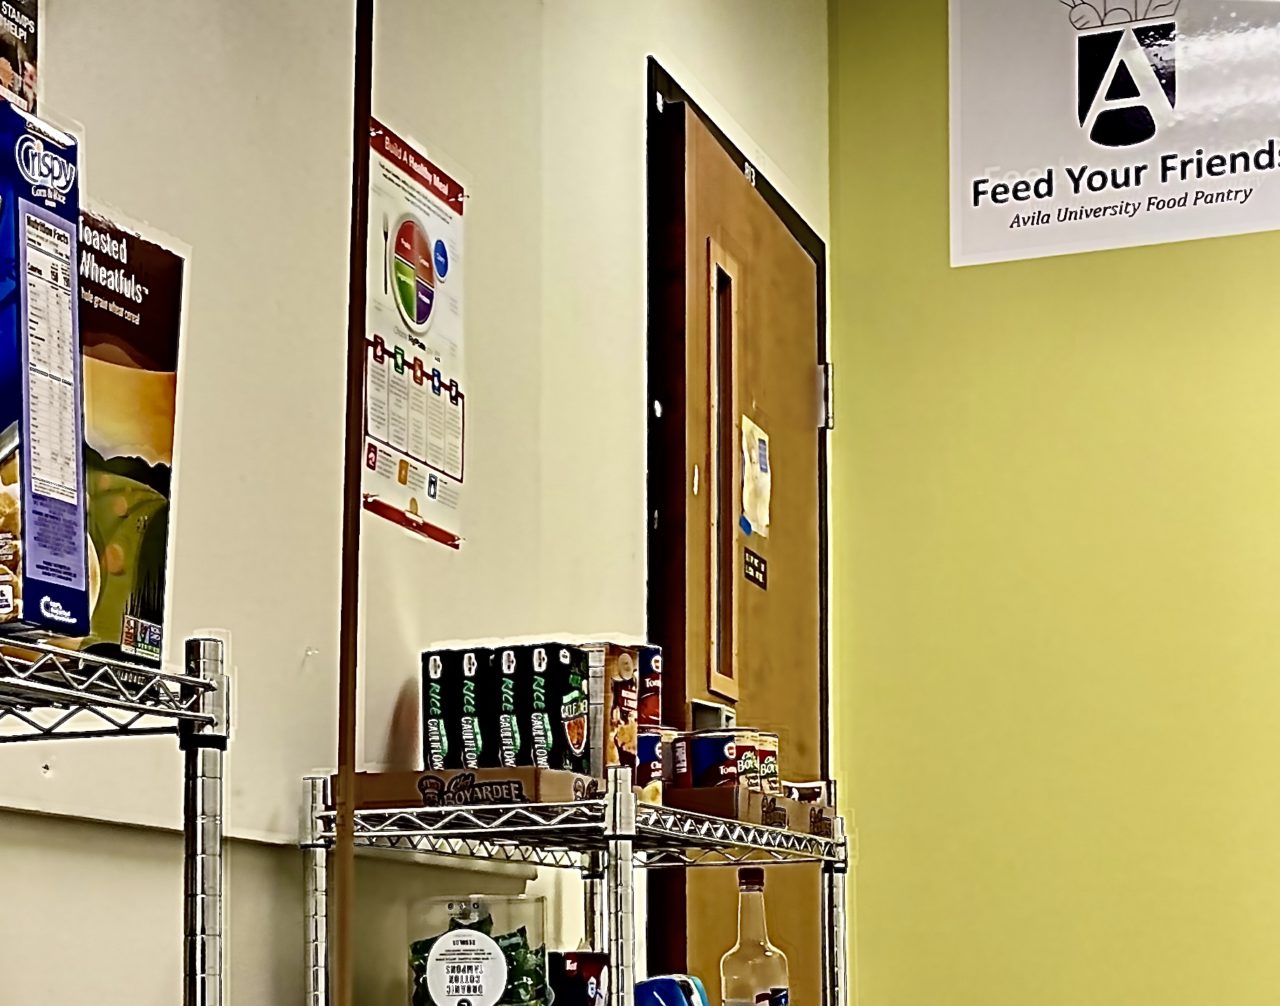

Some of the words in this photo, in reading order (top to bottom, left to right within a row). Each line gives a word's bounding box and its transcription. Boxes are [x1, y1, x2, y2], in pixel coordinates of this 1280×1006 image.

[2, 1, 35, 33] STAMPS
[15, 134, 76, 194] Crispy
[972, 168, 1054, 207] Feed
[1065, 164, 1148, 194] Your
[1160, 138, 1280, 184] Friend
[1009, 210, 1051, 229] Avila
[1056, 200, 1141, 223] University
[1146, 191, 1188, 212] Food
[1192, 186, 1254, 211] Pantry
[78, 215, 128, 265] Toasted
[79, 249, 143, 304] Wheatfuls
[428, 682, 441, 716] RICE
[462, 679, 476, 713] RICE
[501, 677, 515, 711] RICE
[532, 675, 546, 710] RICE
[443, 781, 520, 806] BOYARDEE
[445, 984, 484, 995] ORGANIC
